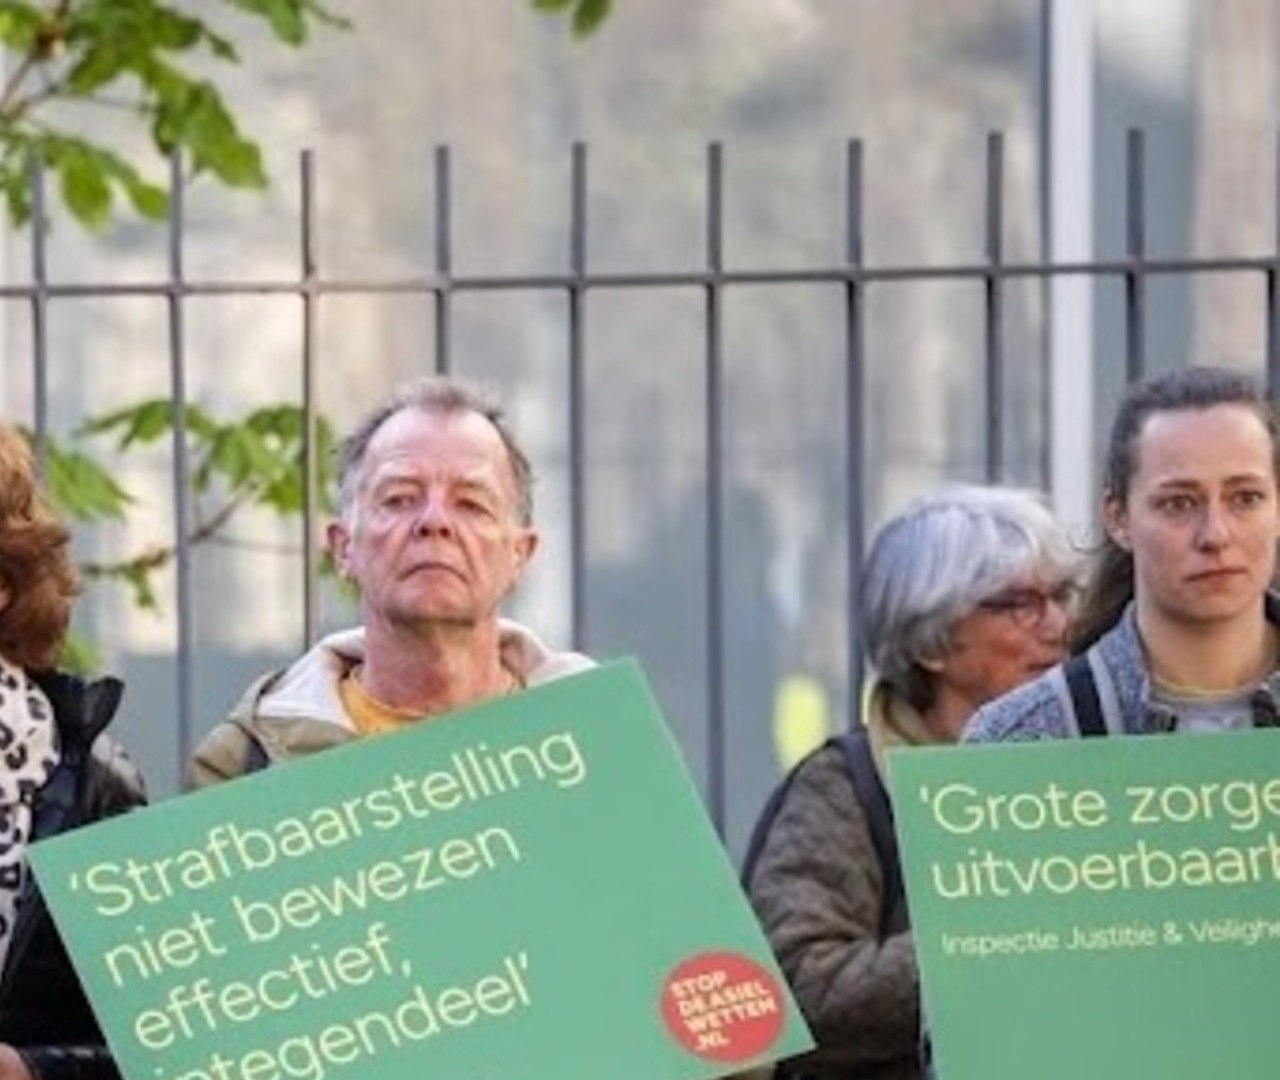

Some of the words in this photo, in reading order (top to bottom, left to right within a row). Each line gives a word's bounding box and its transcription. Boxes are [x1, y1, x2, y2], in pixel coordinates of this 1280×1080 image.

[70, 732, 587, 915] 'Strafbaarstelling
[920, 783, 1107, 833] 'Grote
[1126, 779, 1280, 829] zorge
[932, 834, 1280, 899] uitvoerbaar
[104, 913, 226, 987] niet
[233, 827, 520, 942] bewezen
[942, 932, 1059, 957] Inspectie
[1067, 926, 1157, 949] Justitie
[1163, 922, 1183, 944] &
[1188, 919, 1280, 944] Veilighe
[135, 925, 410, 1049] effectief,
[670, 970, 727, 998] STOP
[677, 995, 706, 1017] DE
[706, 980, 771, 1007] ASIEL
[683, 997, 779, 1033] WETTEN
[694, 1030, 730, 1051] .NL
